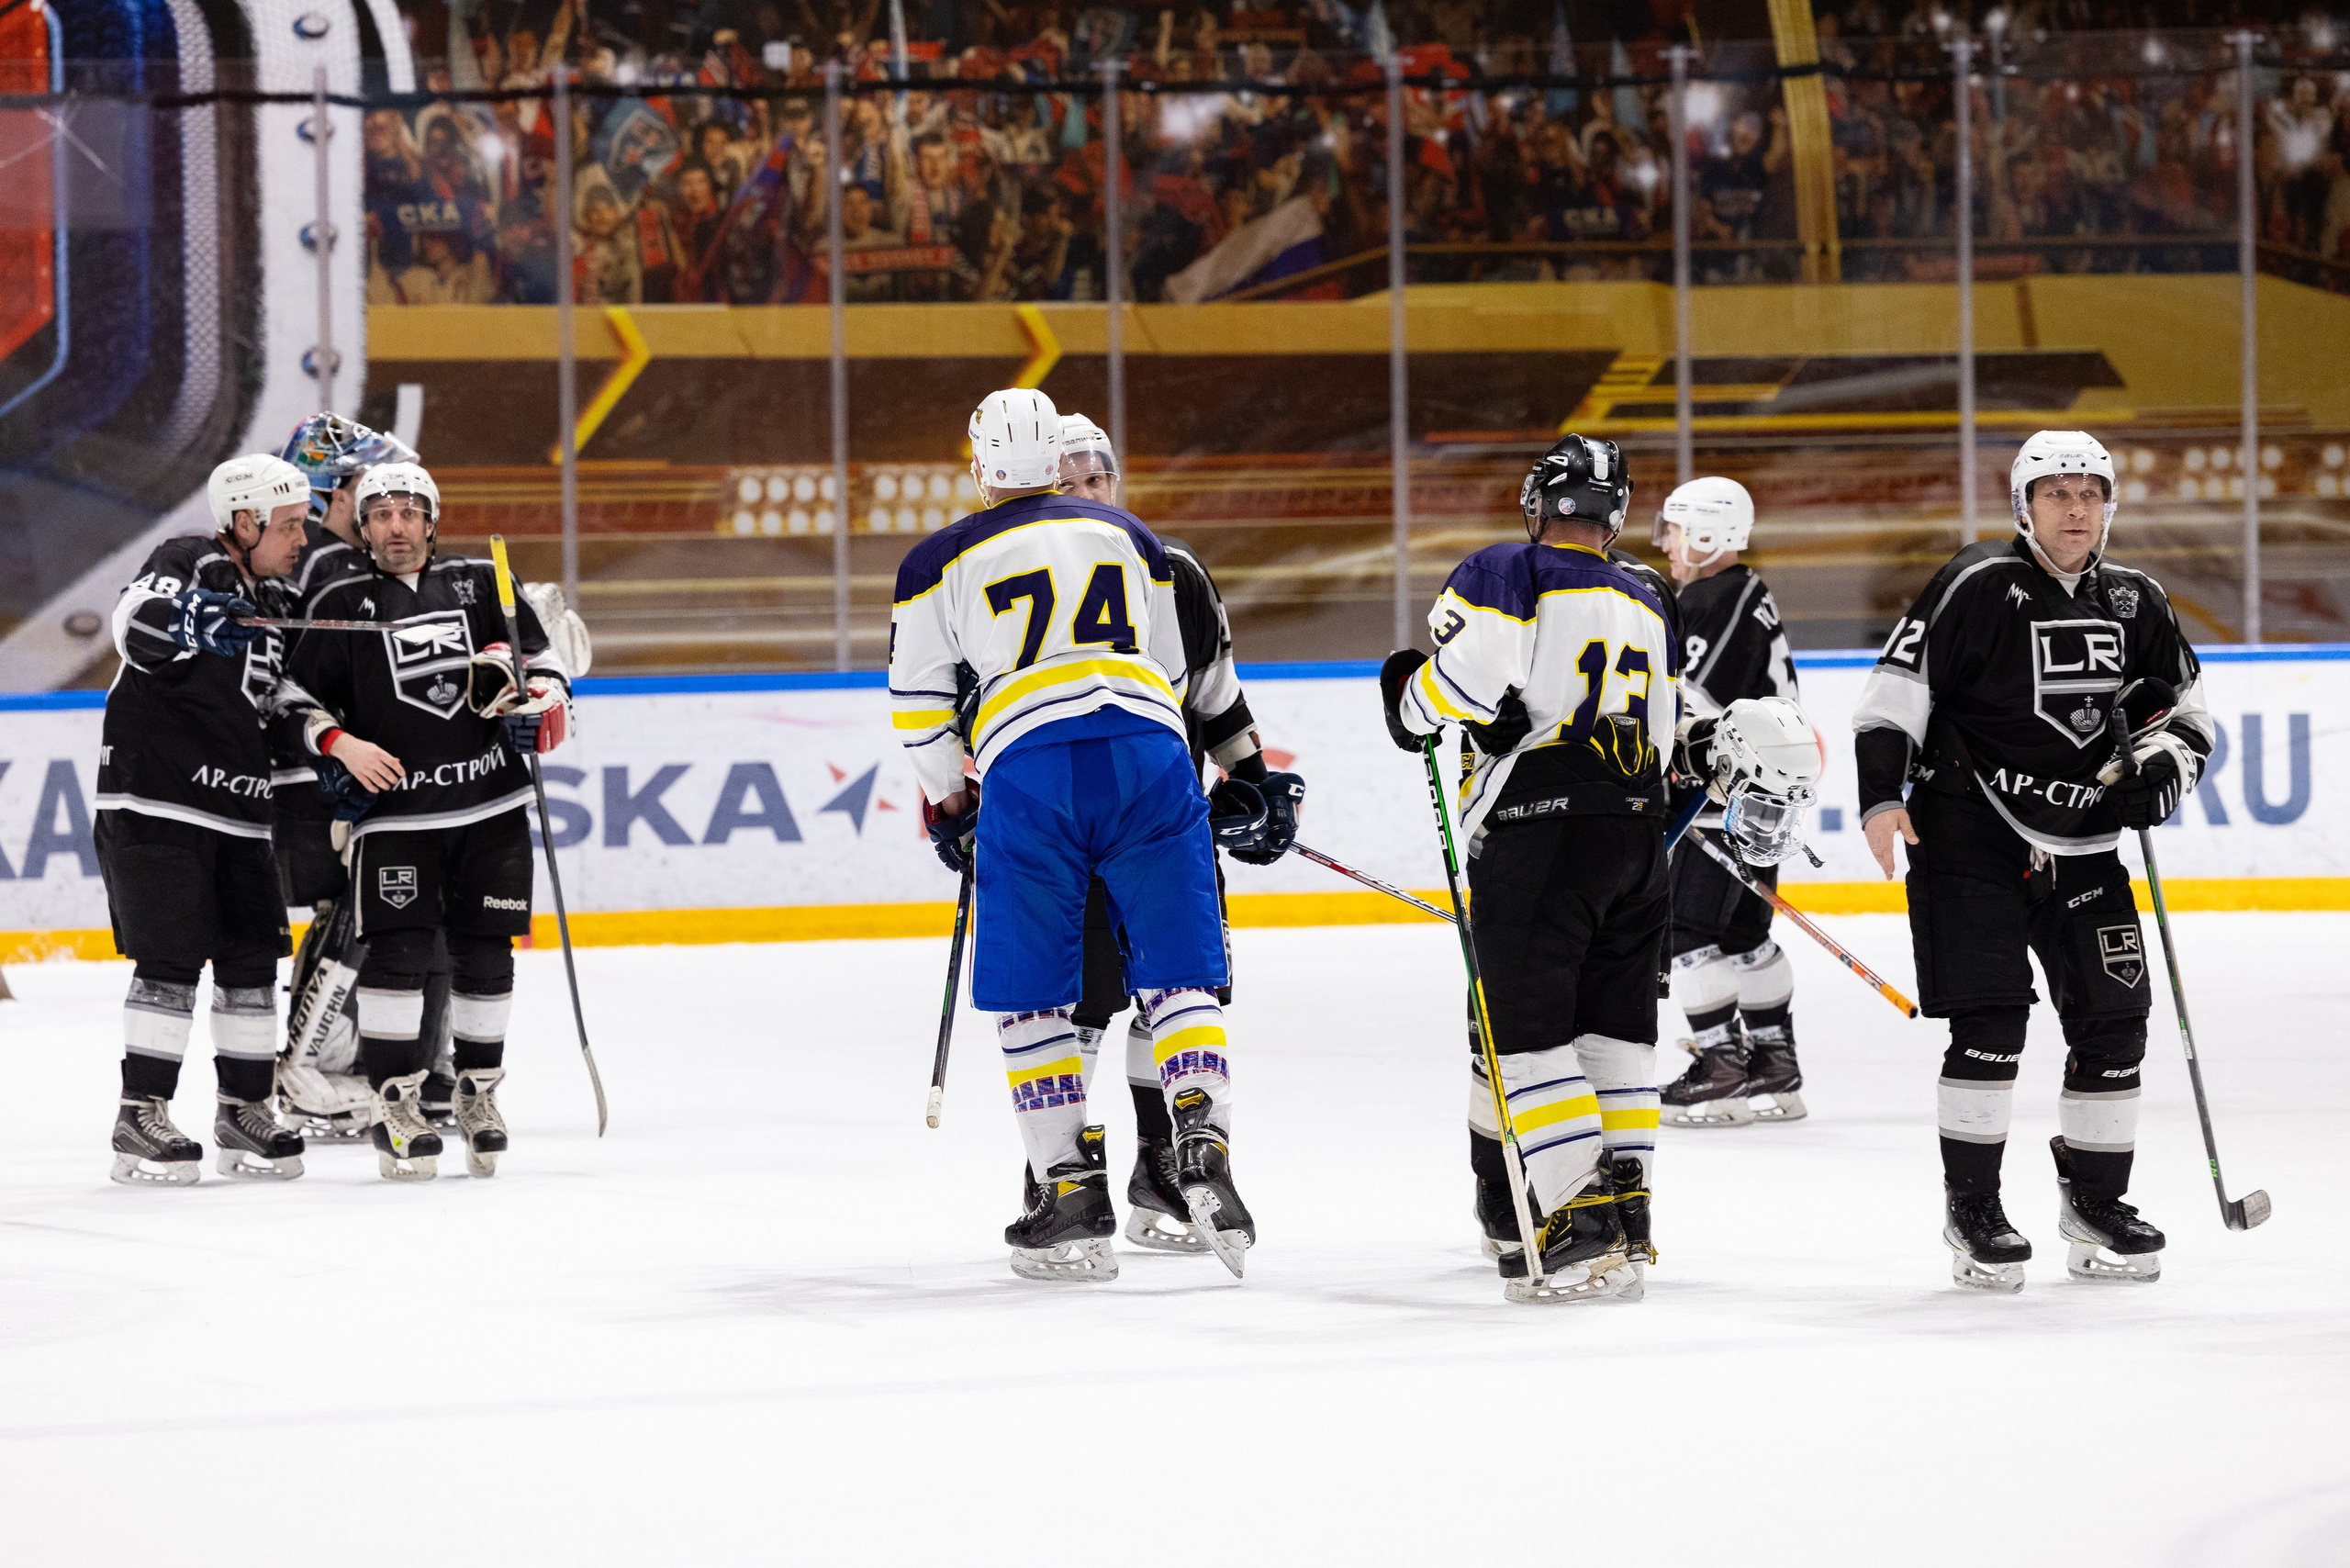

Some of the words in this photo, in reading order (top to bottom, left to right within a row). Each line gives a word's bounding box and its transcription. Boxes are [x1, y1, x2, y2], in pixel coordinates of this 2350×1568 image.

[185, 593, 202, 648] CCM
[982, 561, 1142, 675] 74
[1434, 606, 1466, 646] 3
[2039, 633, 2122, 673] LR
[1496, 797, 1571, 822] BAUER
[383, 870, 413, 885] LR
[483, 895, 528, 912] Reebok
[2066, 887, 2103, 908] CCM
[2102, 932, 2139, 953] LR
[306, 985, 347, 1058] VAUGHN
[1964, 1048, 2020, 1063] BAUE
[2101, 1065, 2141, 1079] BAU
[2075, 1221, 2104, 1243] BAUER
